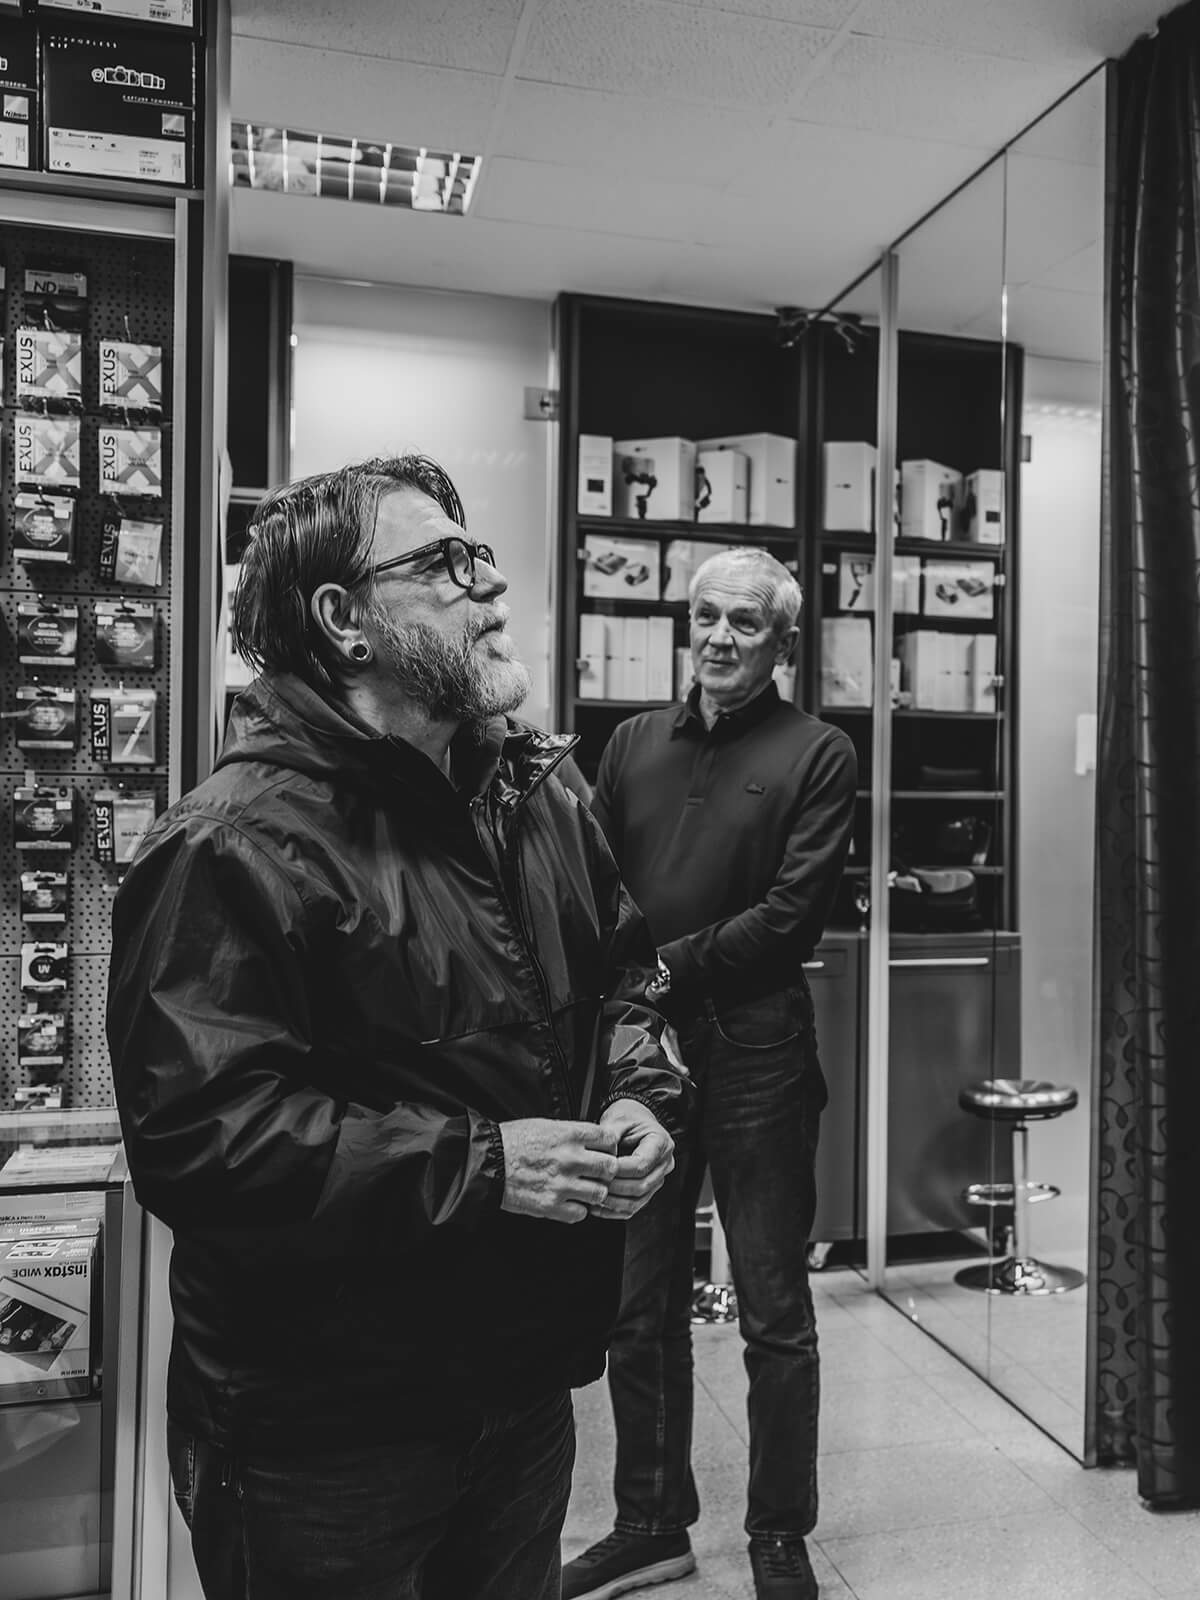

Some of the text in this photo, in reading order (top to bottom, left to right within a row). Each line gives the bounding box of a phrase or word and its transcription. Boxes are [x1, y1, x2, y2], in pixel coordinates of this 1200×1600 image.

[20, 337, 33, 384] EXUS
[103, 348, 116, 394] EXUS
[19, 425, 32, 472] EXUS
[103, 435, 116, 481] EXUS
[38, 963, 51, 974] UV
[12, 1264, 87, 1278] instax WIDE
